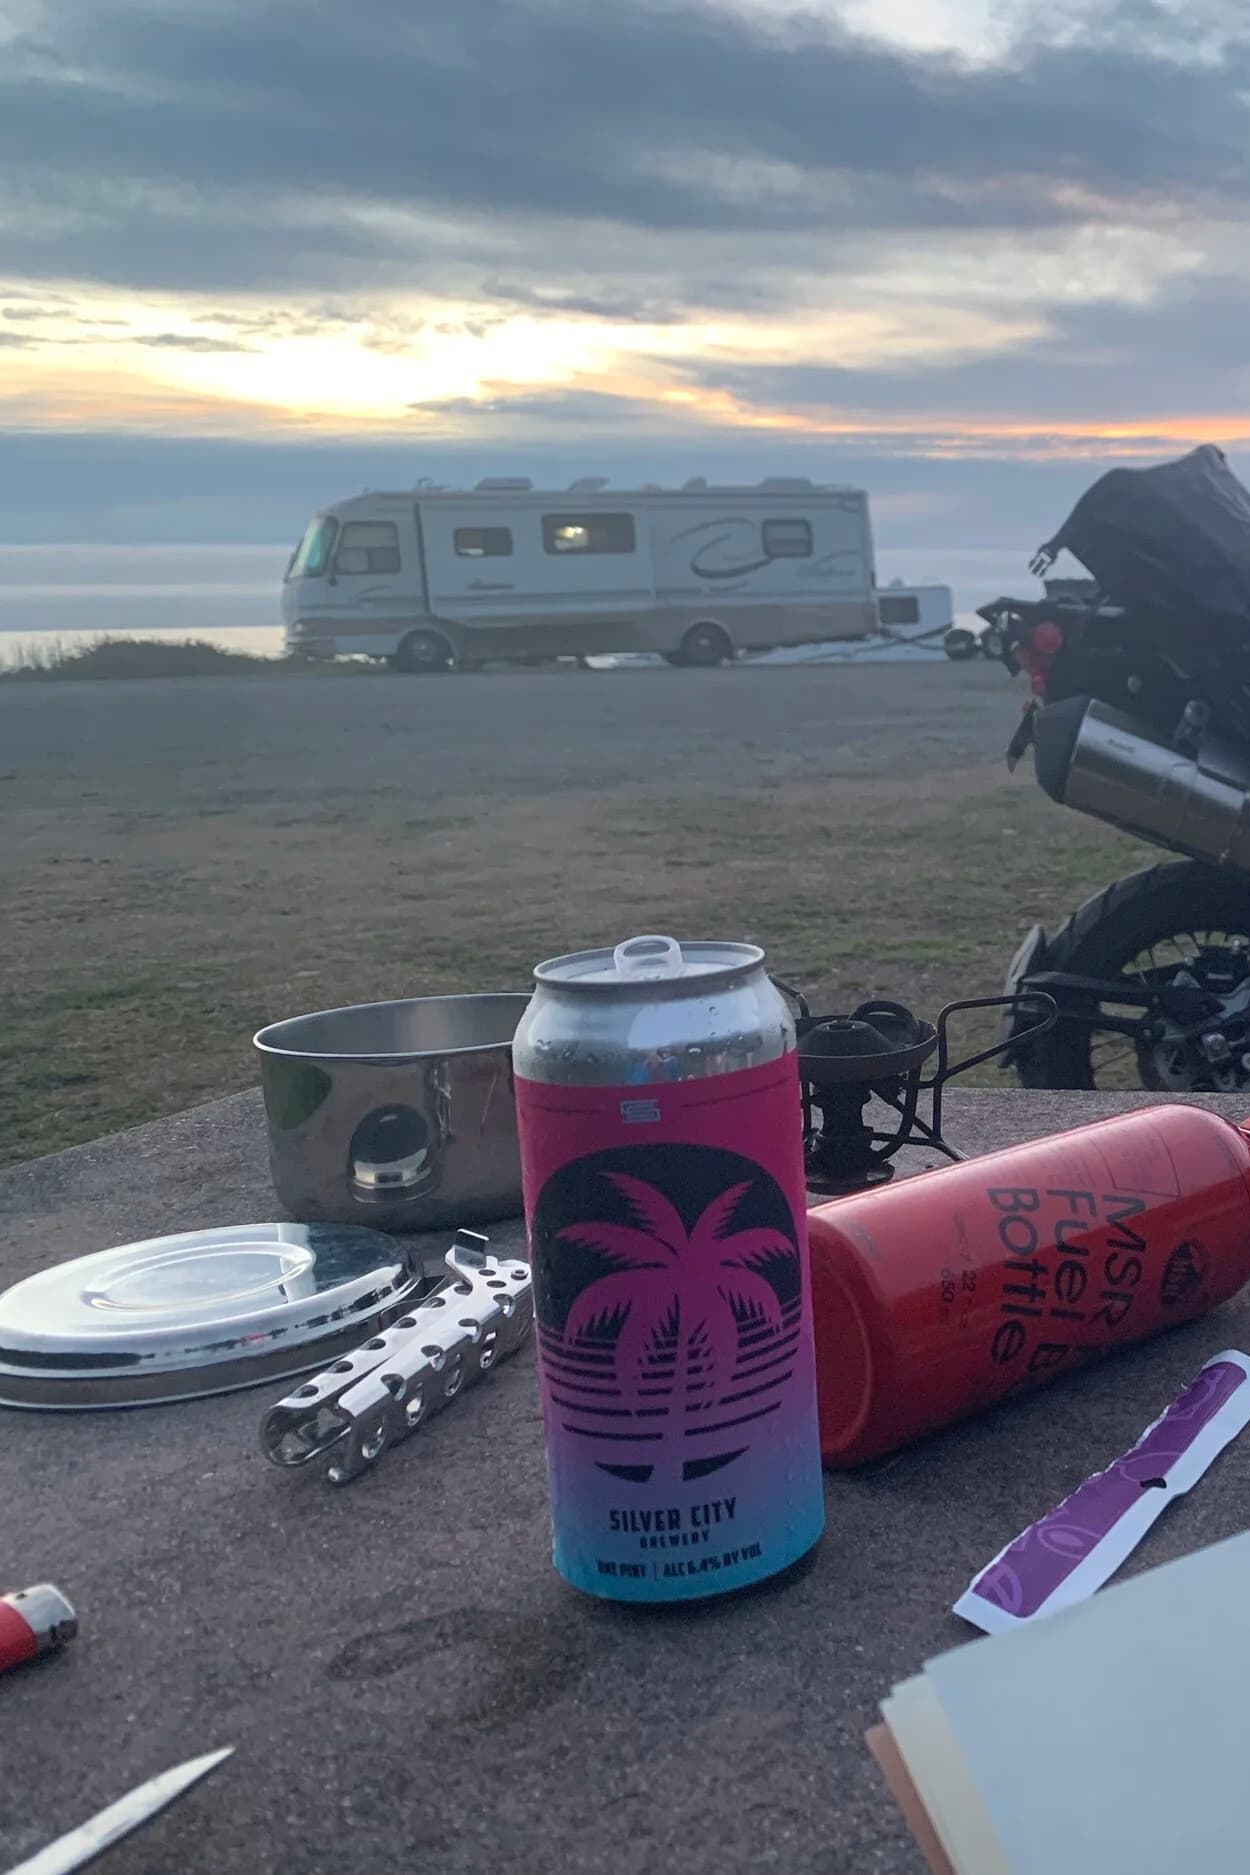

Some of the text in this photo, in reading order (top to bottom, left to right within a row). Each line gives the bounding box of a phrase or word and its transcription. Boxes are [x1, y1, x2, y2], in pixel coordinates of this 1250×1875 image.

[986, 1186, 1049, 1364] Bottle
[1046, 1188, 1098, 1322] Fuel
[1091, 1193, 1147, 1328] MSR
[608, 1495, 737, 1533] SILVER CITY
[639, 1528, 710, 1550] BREWERY
[619, 1562, 647, 1579] PINT
[663, 1561, 686, 1578] ALC
[723, 1550, 740, 1568] BY
[741, 1540, 763, 1561] VOL
